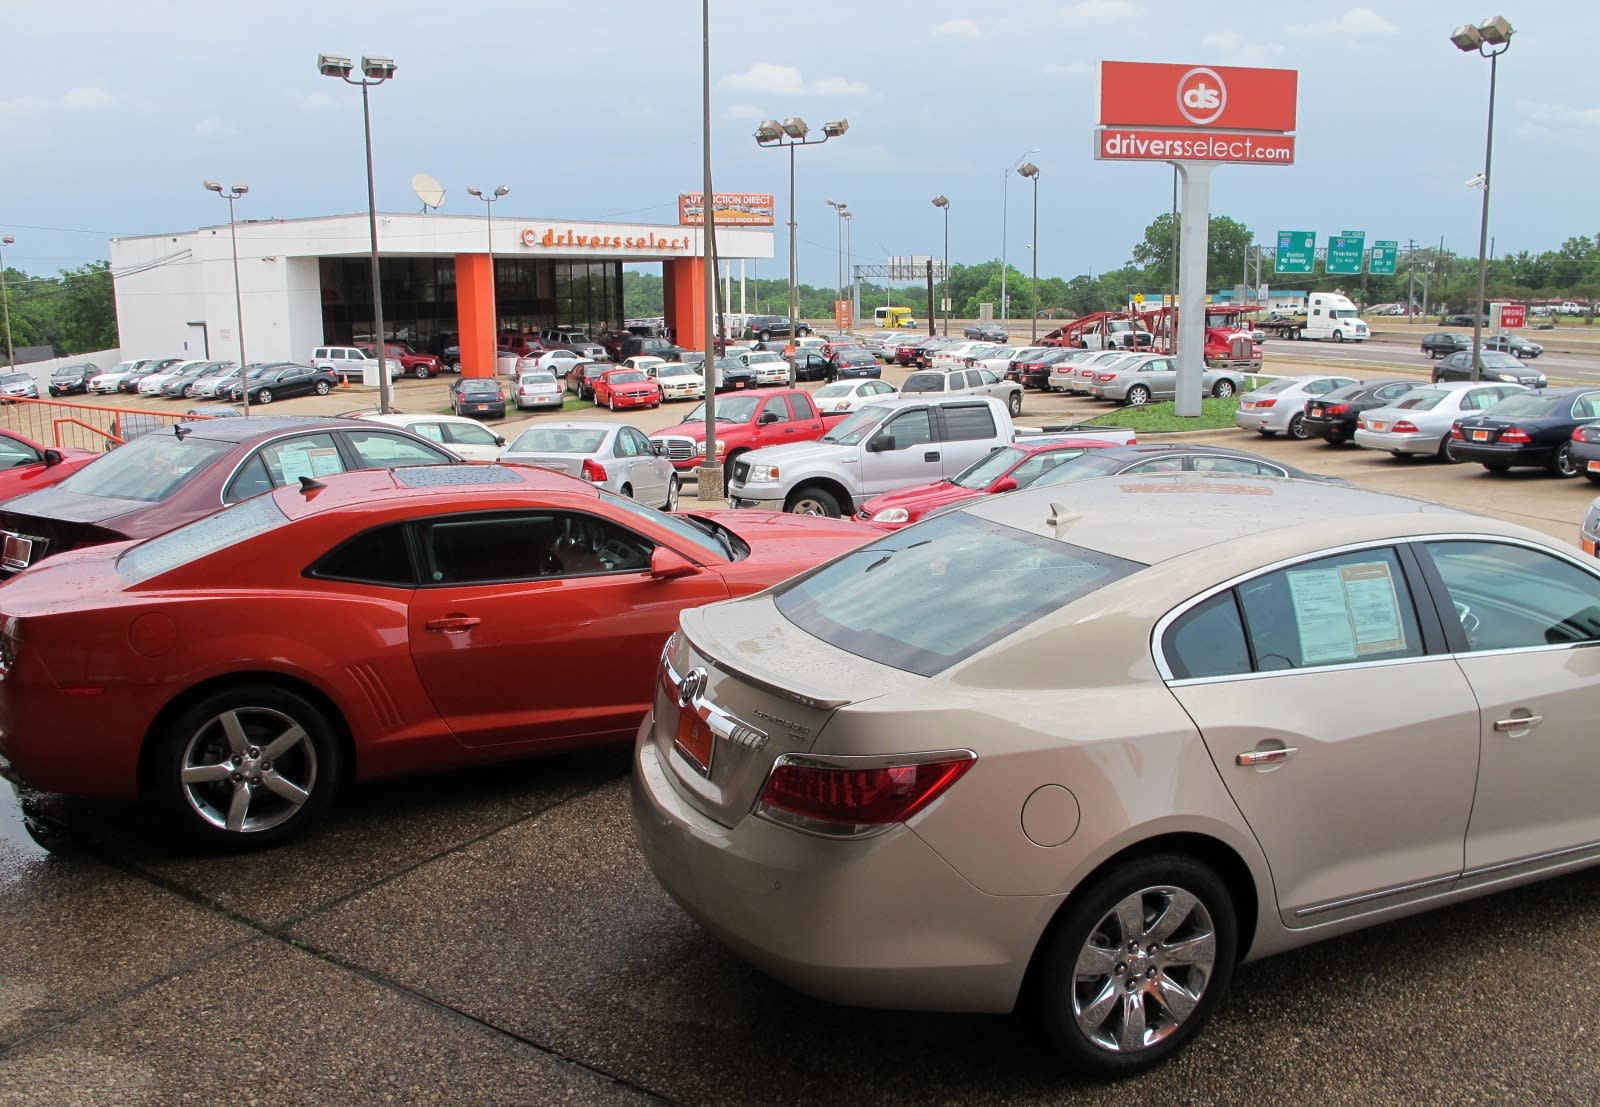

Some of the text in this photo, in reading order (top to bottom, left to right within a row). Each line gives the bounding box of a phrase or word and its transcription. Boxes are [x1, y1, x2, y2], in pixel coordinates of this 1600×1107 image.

[1183, 83, 1220, 109] ds
[1105, 134, 1290, 159] driversselect.com
[743, 195, 770, 204] DIRECT
[542, 228, 689, 250] driversselect
[1502, 308, 1522, 317] WRONG
